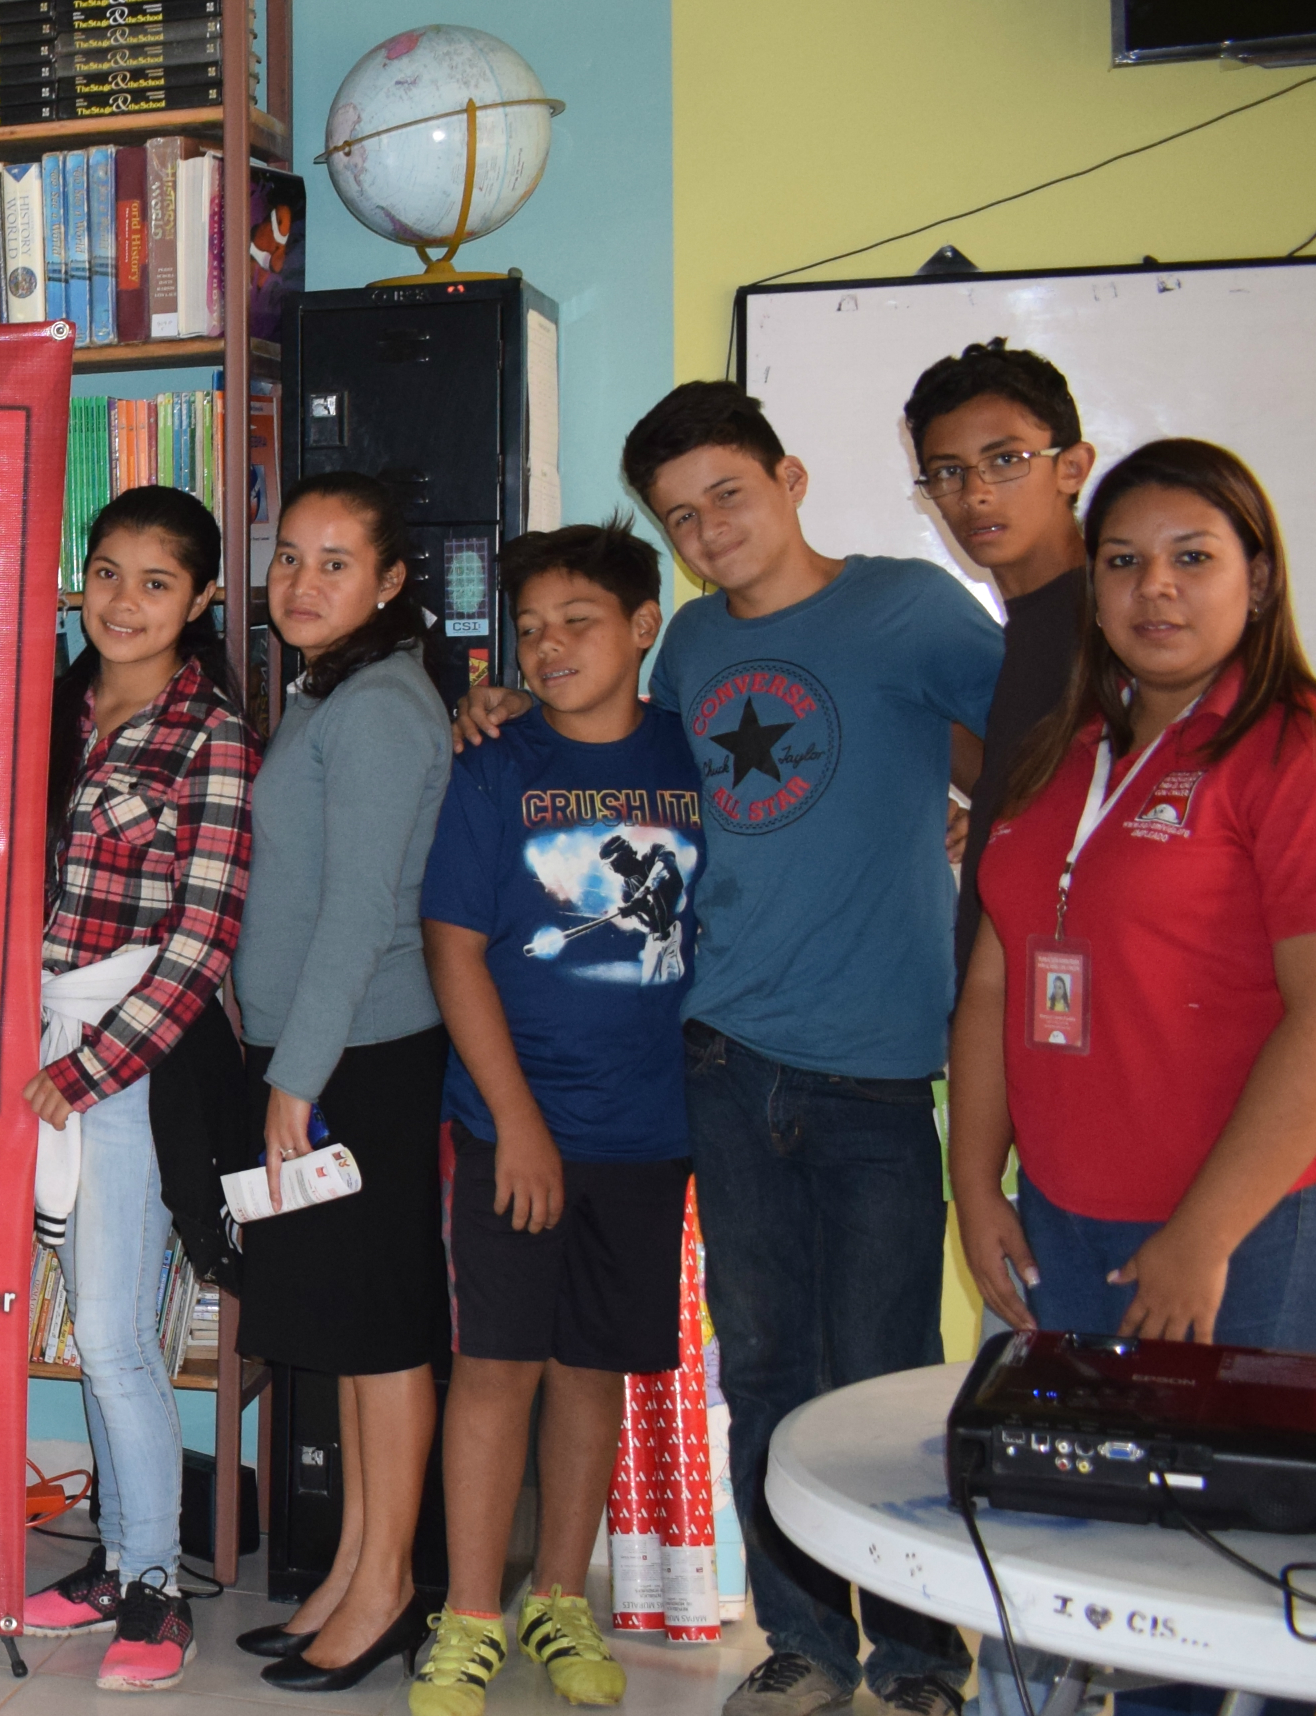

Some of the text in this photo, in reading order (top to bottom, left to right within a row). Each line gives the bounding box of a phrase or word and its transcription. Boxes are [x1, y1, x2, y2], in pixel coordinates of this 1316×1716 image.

[7, 198, 17, 259] WORLD
[19, 195, 30, 257] HISTORY
[131, 234, 142, 282] History
[693, 672, 817, 737] CONVERSE
[702, 745, 825, 778] Chuck Taylor
[522, 790, 701, 828] CRUSH IT!
[713, 776, 811, 822] ALL STAR
[1132, 1374, 1196, 1387] EPSON
[1053, 1595, 1074, 1617] I
